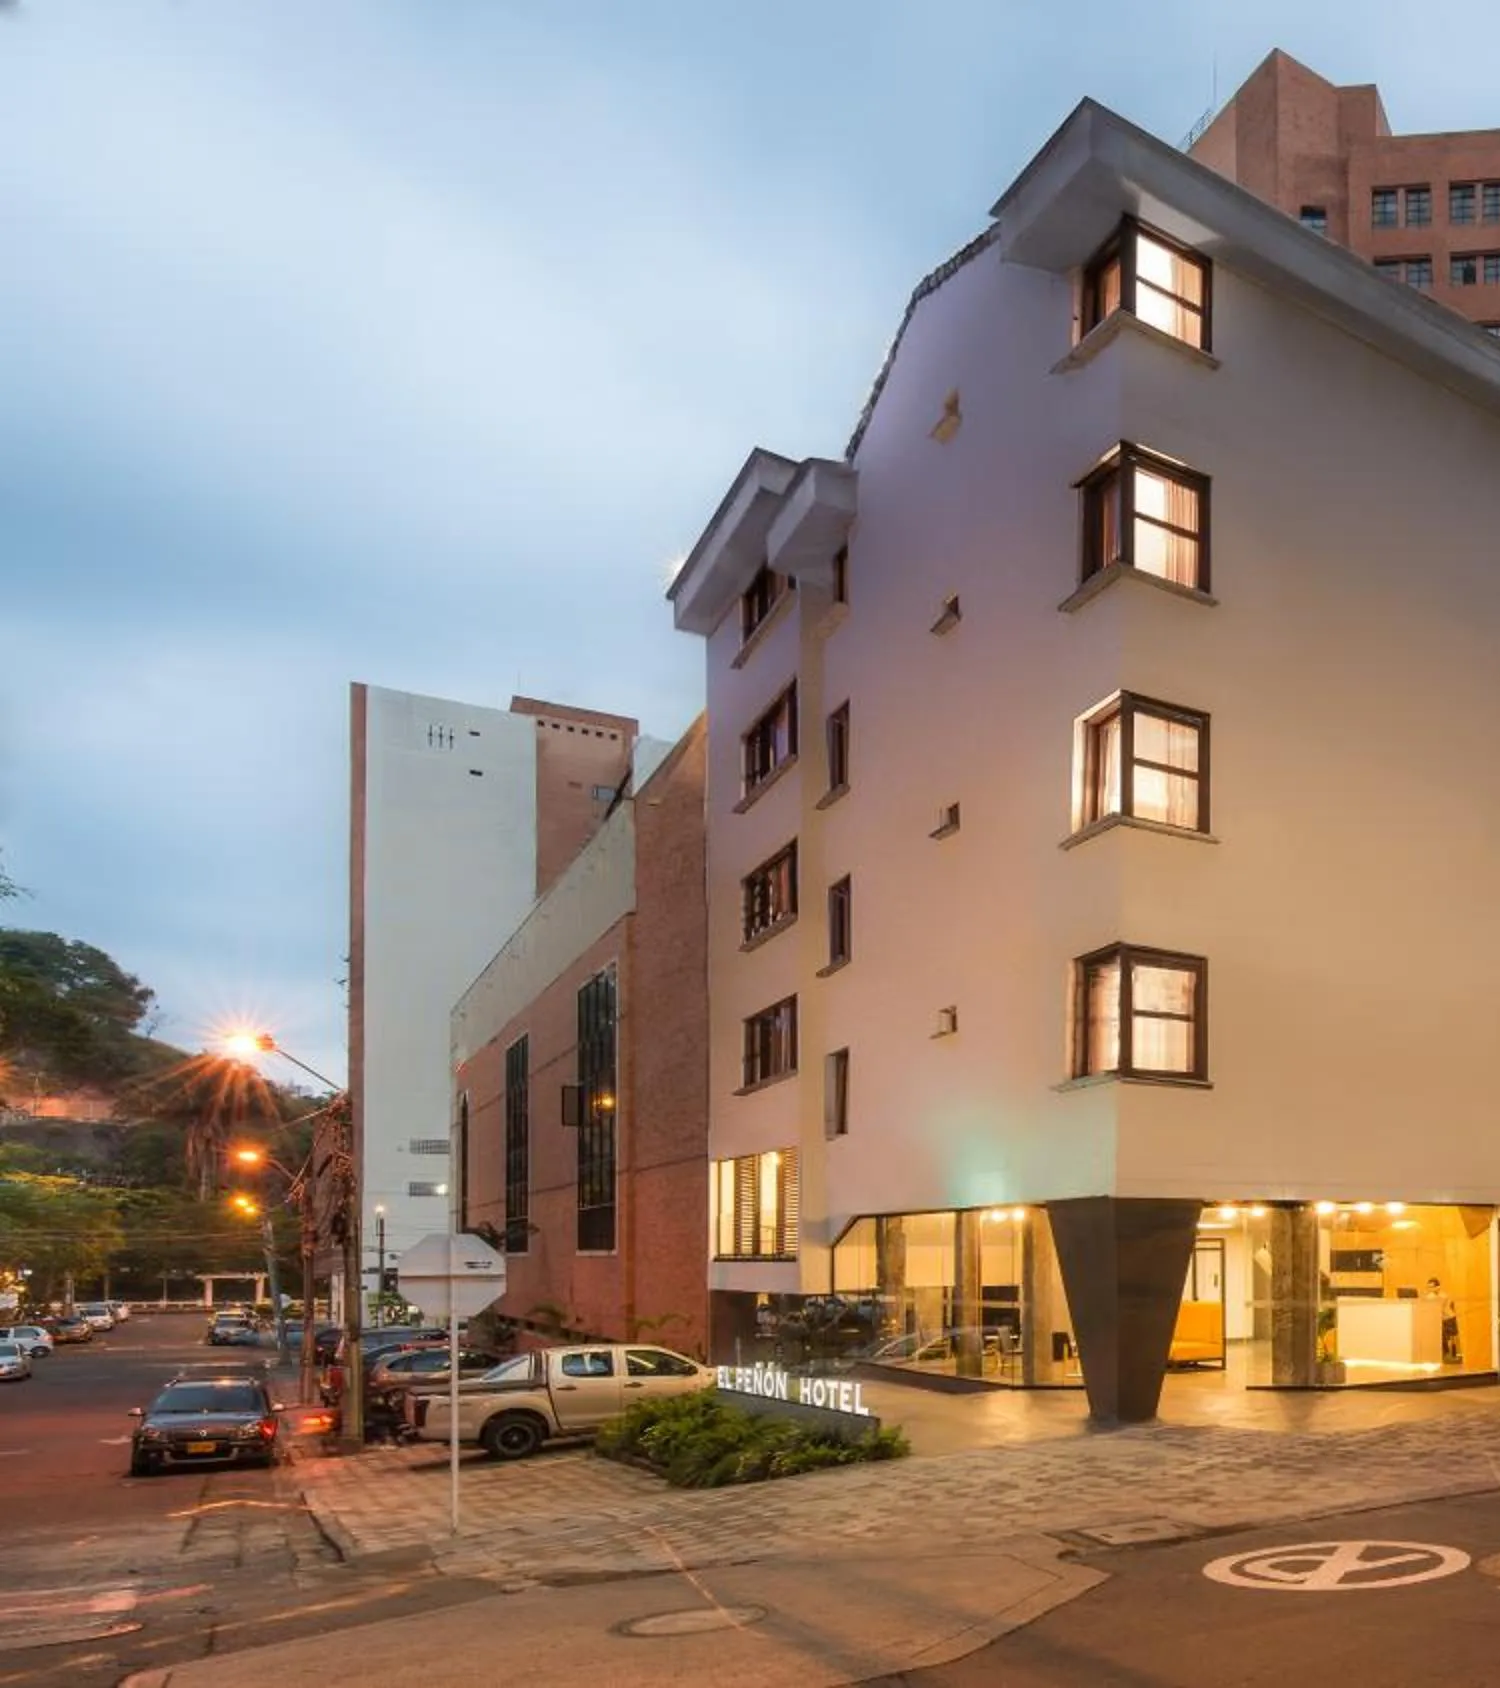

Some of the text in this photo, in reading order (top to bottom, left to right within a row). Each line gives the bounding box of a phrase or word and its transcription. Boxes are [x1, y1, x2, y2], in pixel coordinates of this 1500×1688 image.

[717, 1361, 869, 1416] EL PEÑÓN HOTEL
